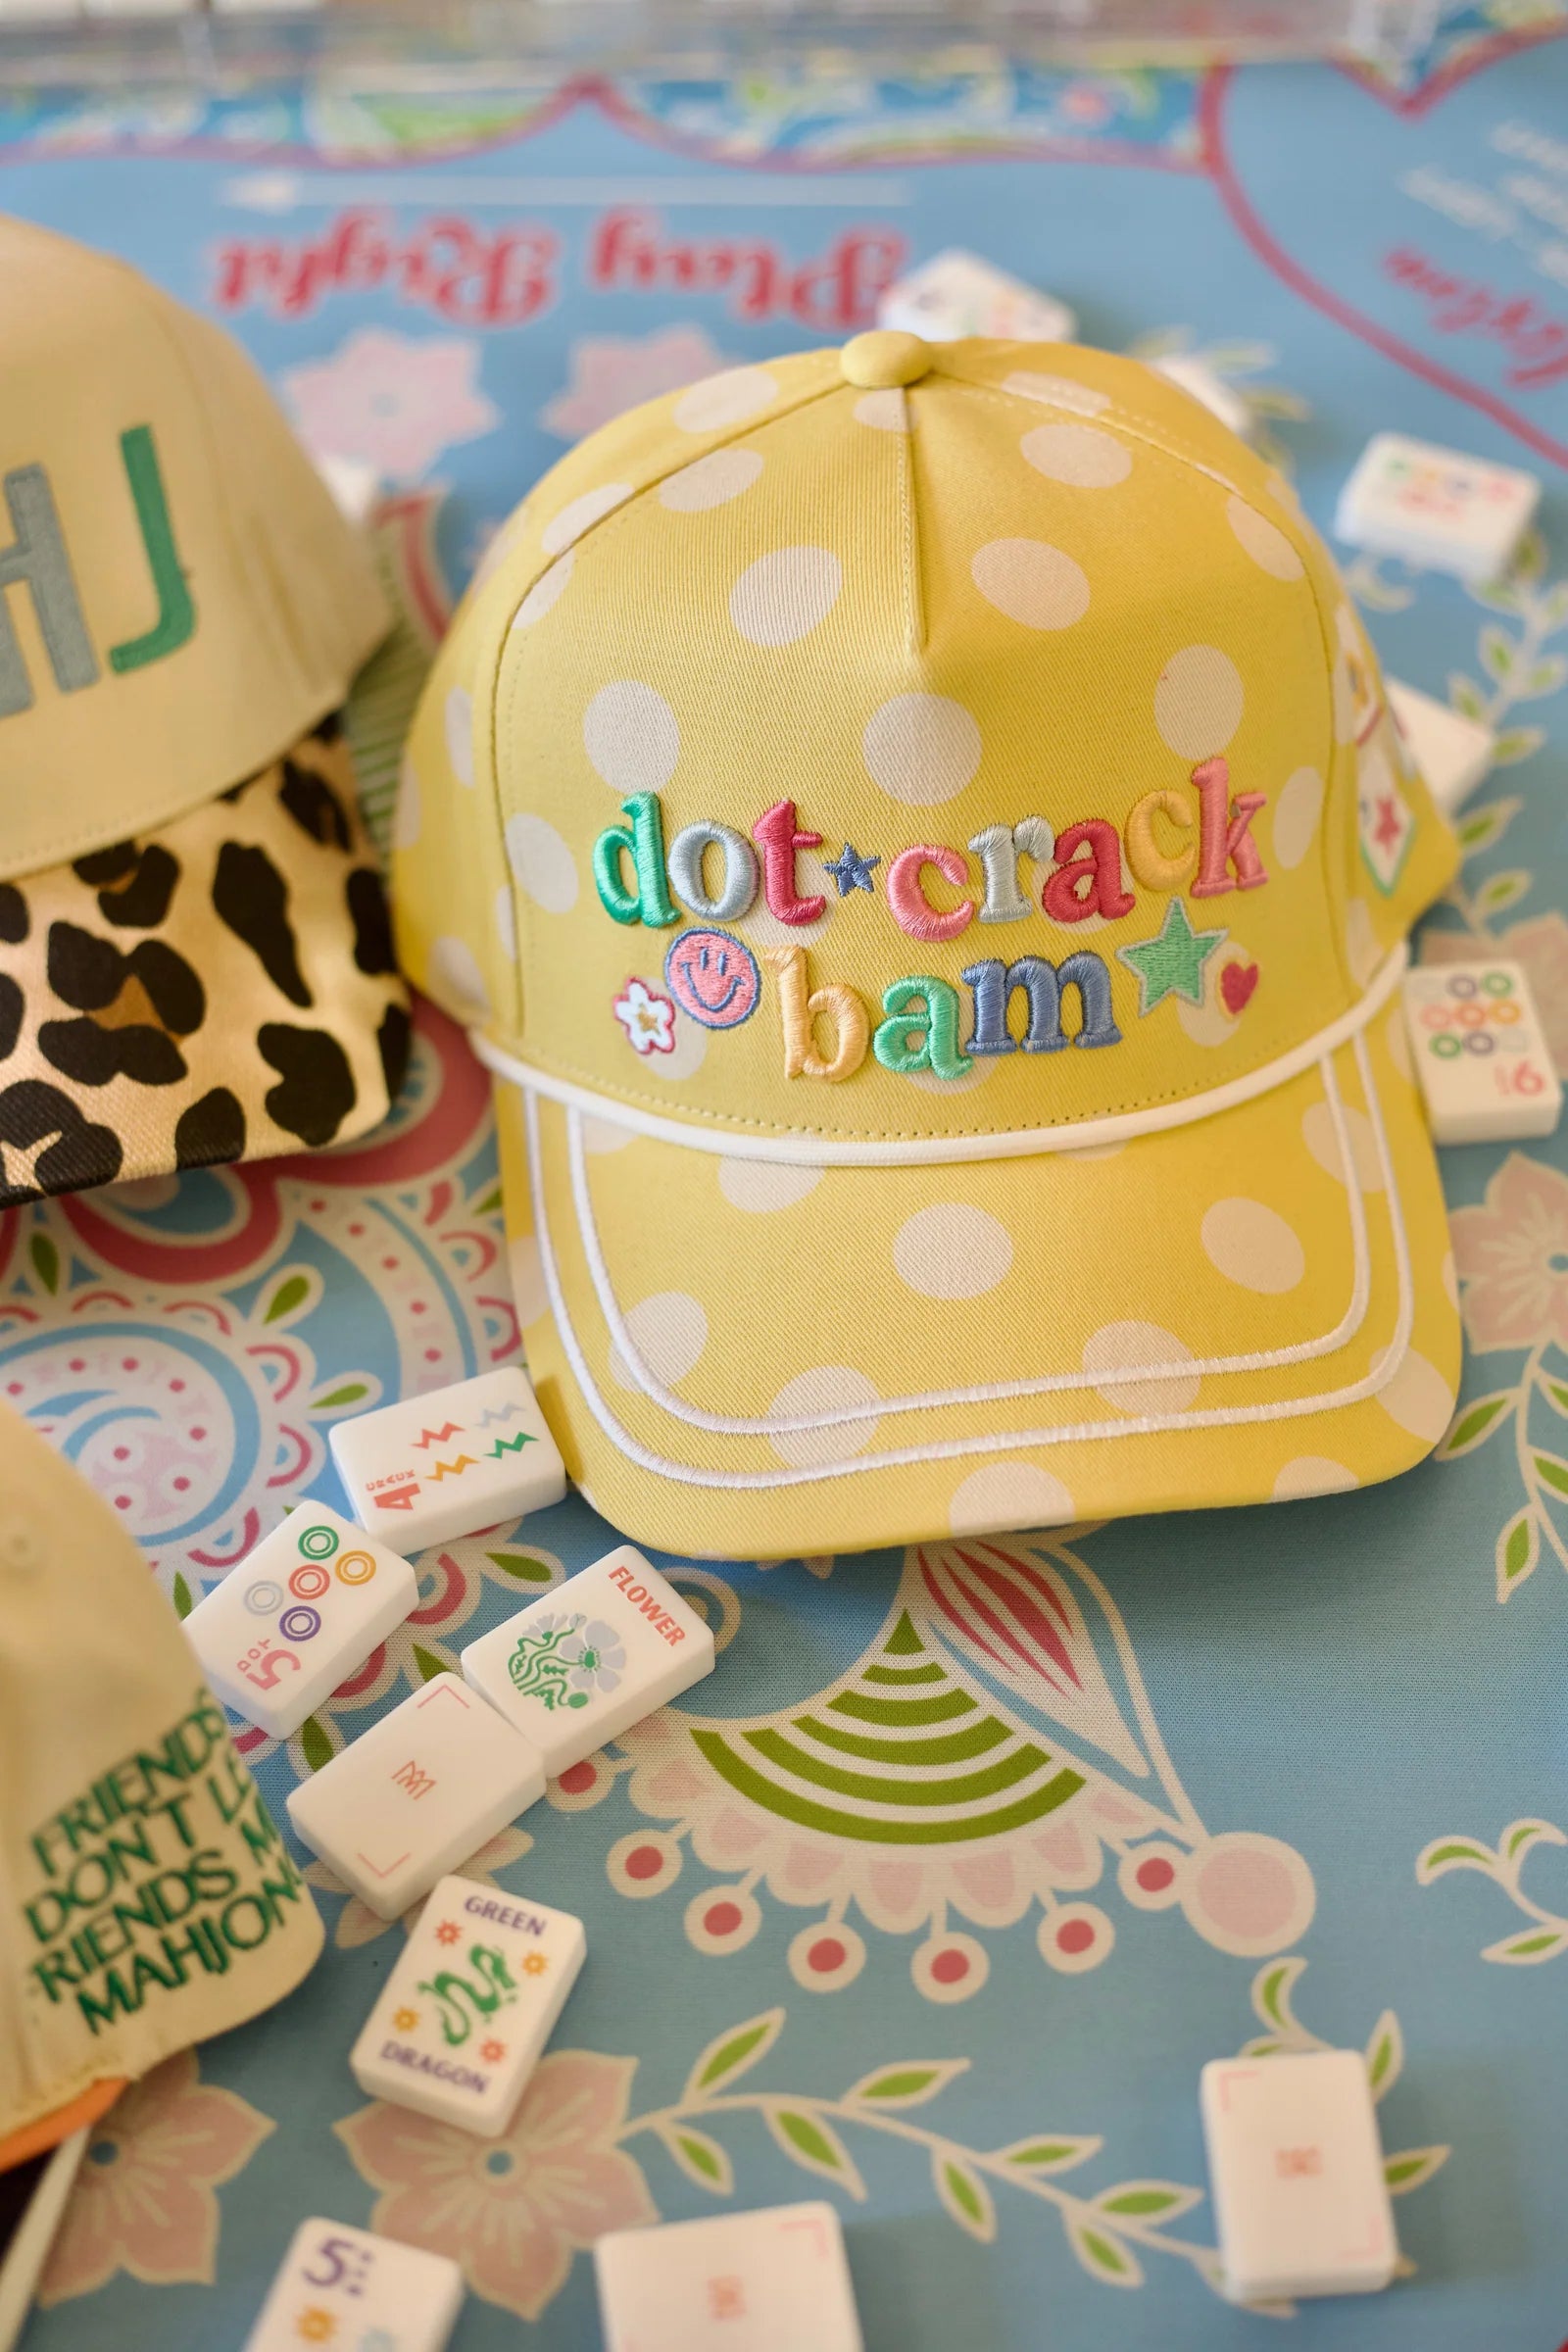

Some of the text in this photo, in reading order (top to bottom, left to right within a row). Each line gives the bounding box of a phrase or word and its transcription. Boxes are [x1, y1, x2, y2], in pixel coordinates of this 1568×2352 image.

[220, 204, 904, 331] Play Right
[592, 757, 1269, 943] dot crack
[763, 947, 1122, 1080] bam
[373, 1482, 421, 1510] 4
[608, 1565, 685, 1647] FLOWER
[236, 1638, 270, 1672] DOT
[245, 1648, 301, 1690] 5
[31, 1848, 237, 2003] RIENDS
[76, 1852, 303, 2036] MAHJON
[464, 1895, 547, 1937] GREEN
[380, 2040, 489, 2094] DRAGON
